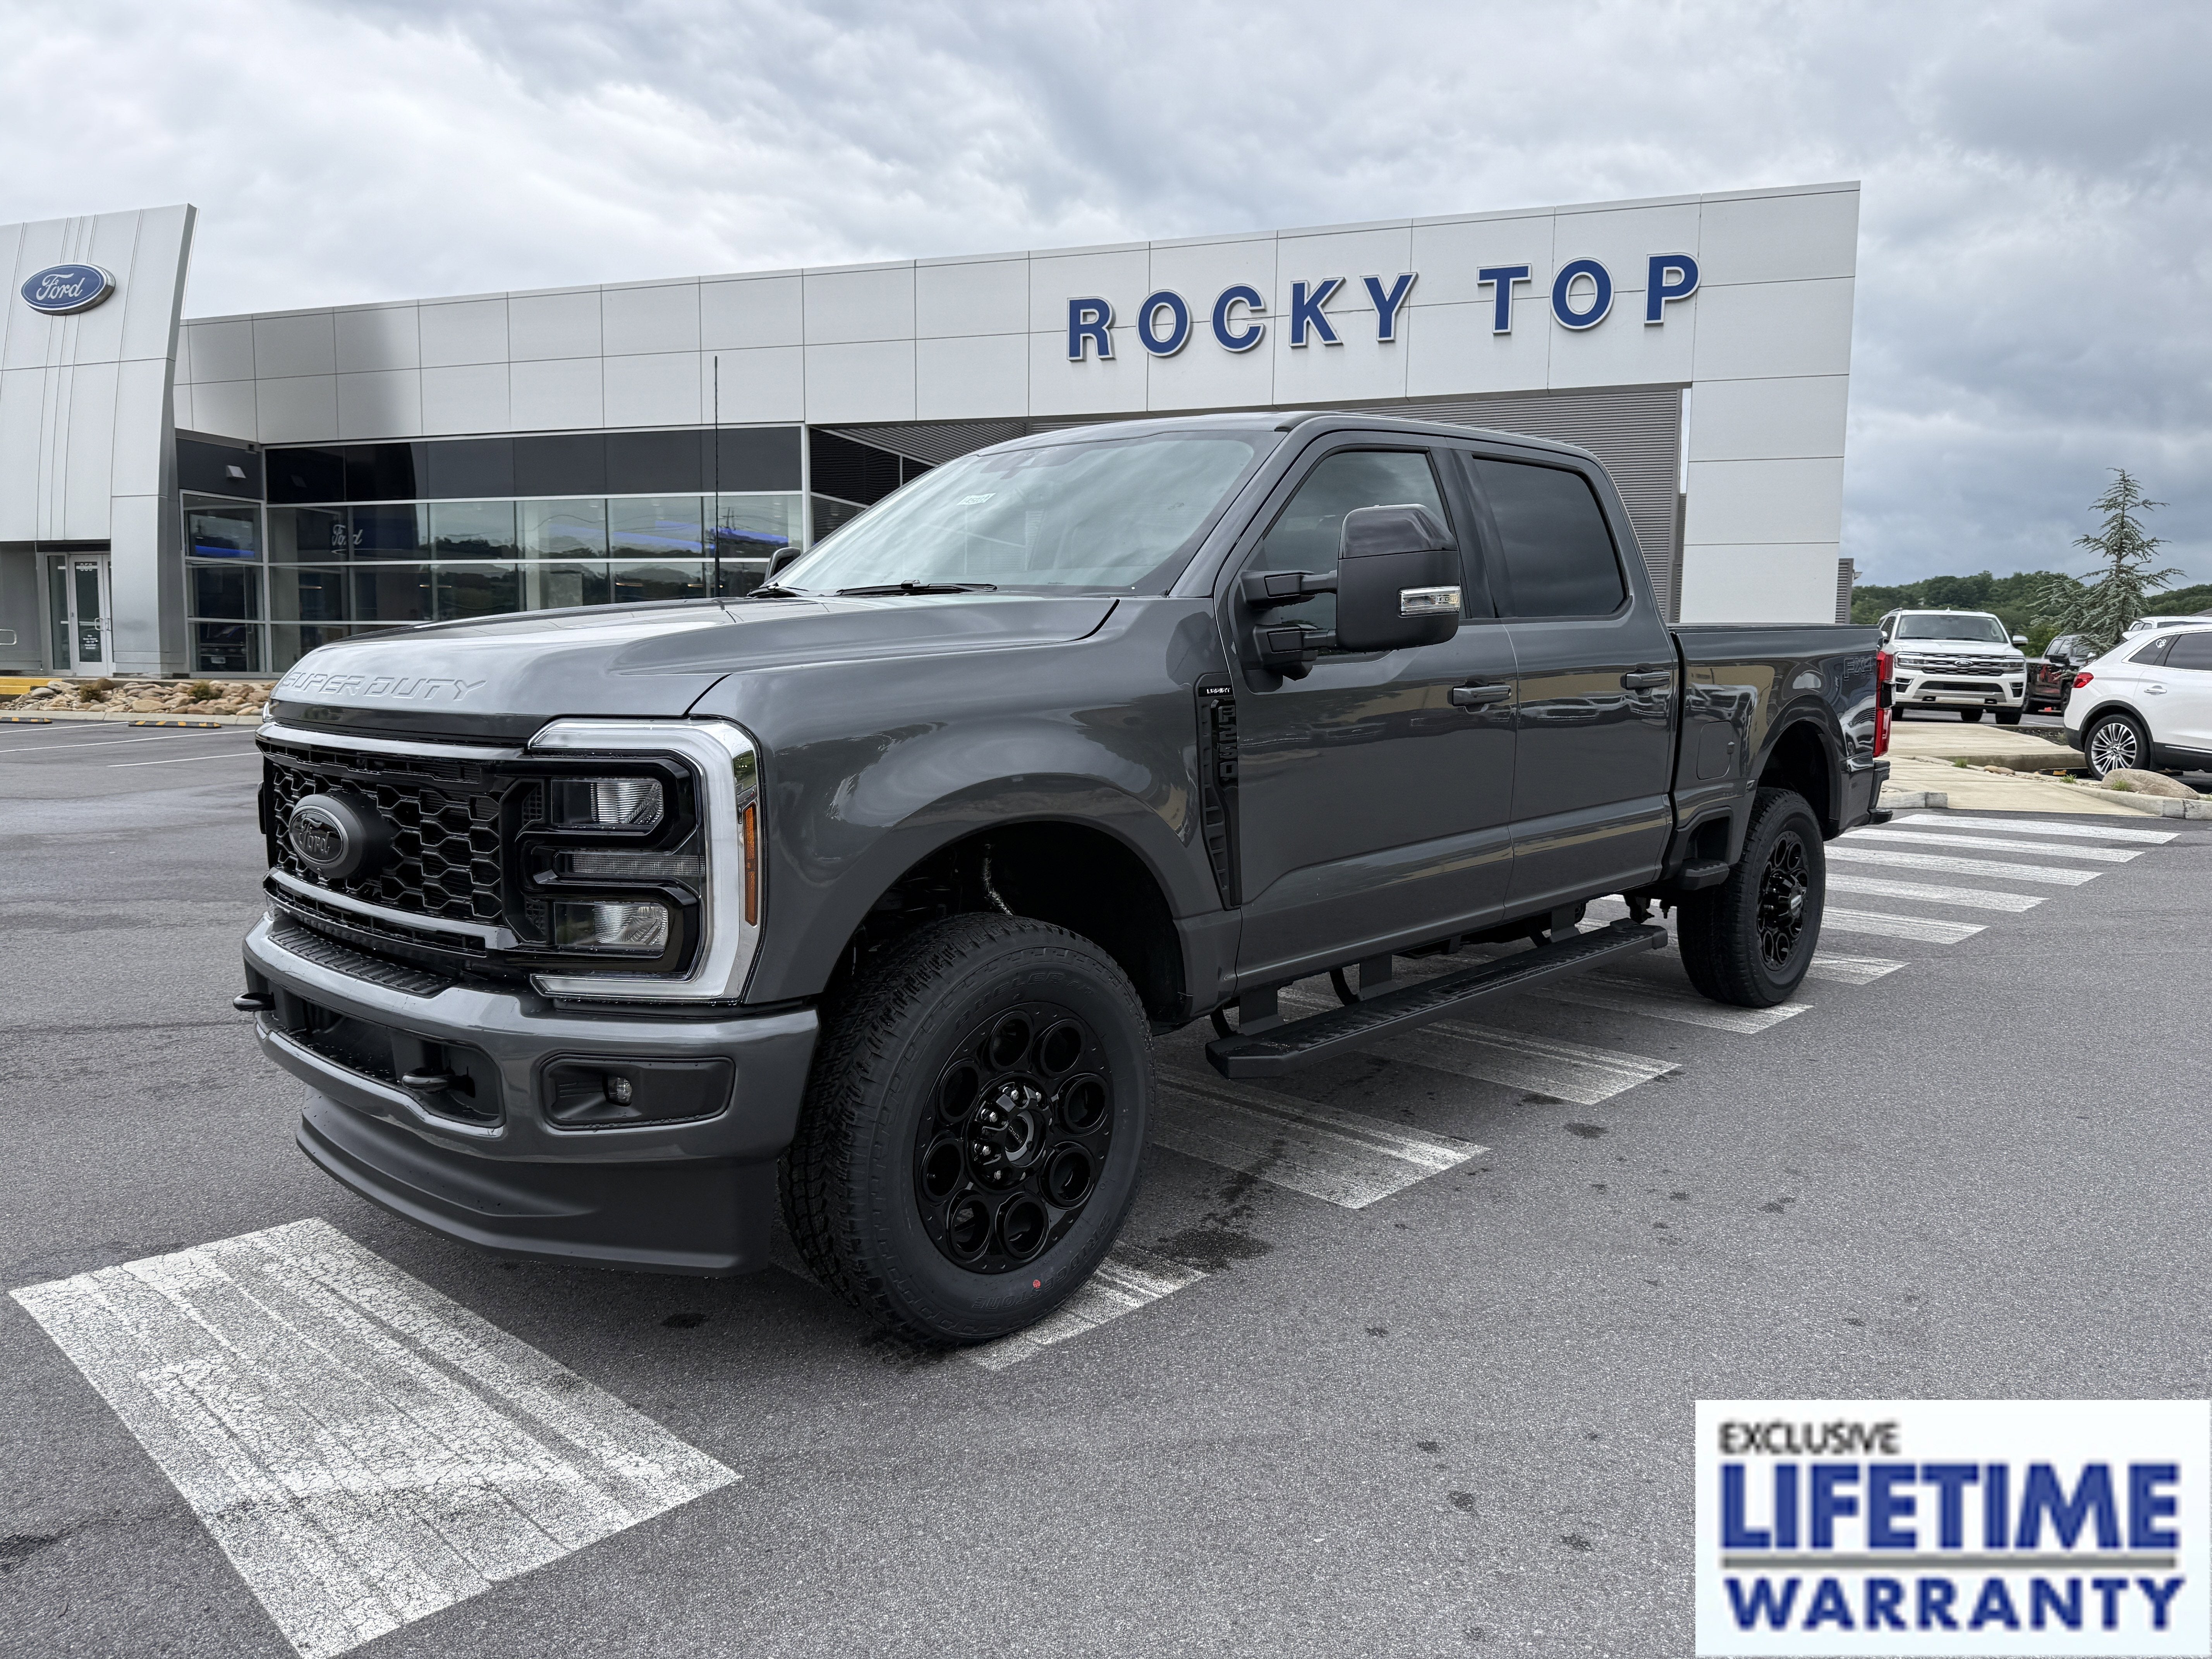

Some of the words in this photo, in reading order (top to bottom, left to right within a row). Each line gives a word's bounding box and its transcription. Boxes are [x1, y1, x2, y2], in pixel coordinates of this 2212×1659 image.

[36, 273, 85, 300] Ford
[1068, 272, 1416, 359] ROCKY
[1477, 253, 1700, 331] TOP
[1844, 655, 1873, 680] FX4
[280, 672, 365, 696] SUPER
[363, 677, 487, 701] DUTY
[298, 817, 330, 855] Ford
[972, 1211, 1111, 1310] BRIDGESTONE
